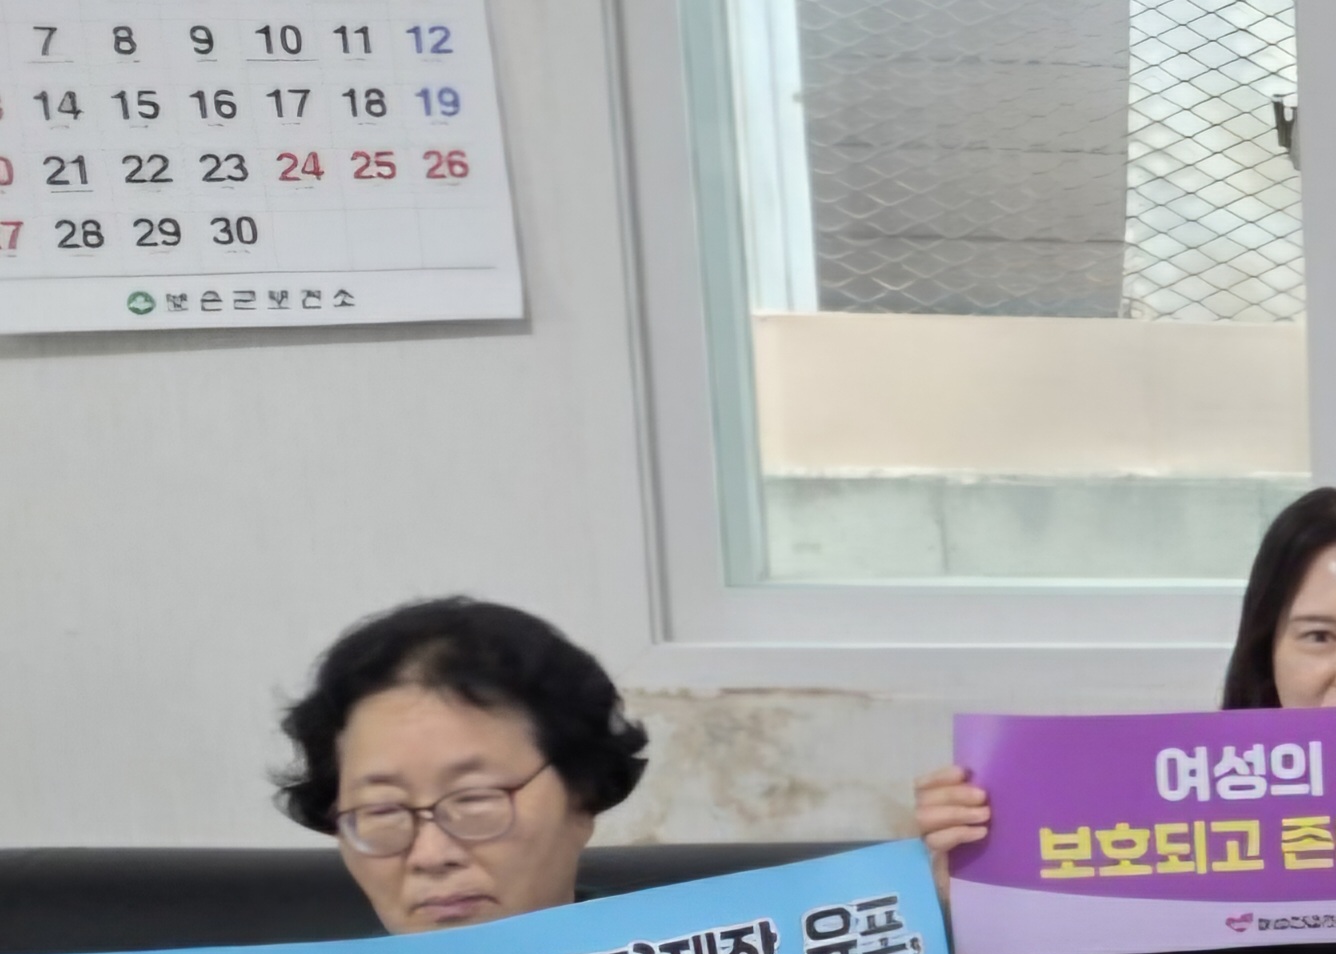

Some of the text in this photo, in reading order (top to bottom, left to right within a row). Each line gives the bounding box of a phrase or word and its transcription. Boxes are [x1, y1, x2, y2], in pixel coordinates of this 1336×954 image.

[33, 25, 453, 56] 7 8 9 10 11 12
[33, 87, 461, 120] 14 15 16 17 18 19
[43, 155, 88, 185] 21
[121, 154, 174, 183] 22
[199, 154, 249, 182] 23
[276, 152, 324, 181] 24
[351, 151, 396, 179] 25
[423, 150, 469, 179] 26
[0, 216, 258, 250] 7 28 29 30
[1156, 741, 1323, 801] 여성의
[1039, 821, 1264, 878] 보호되고
